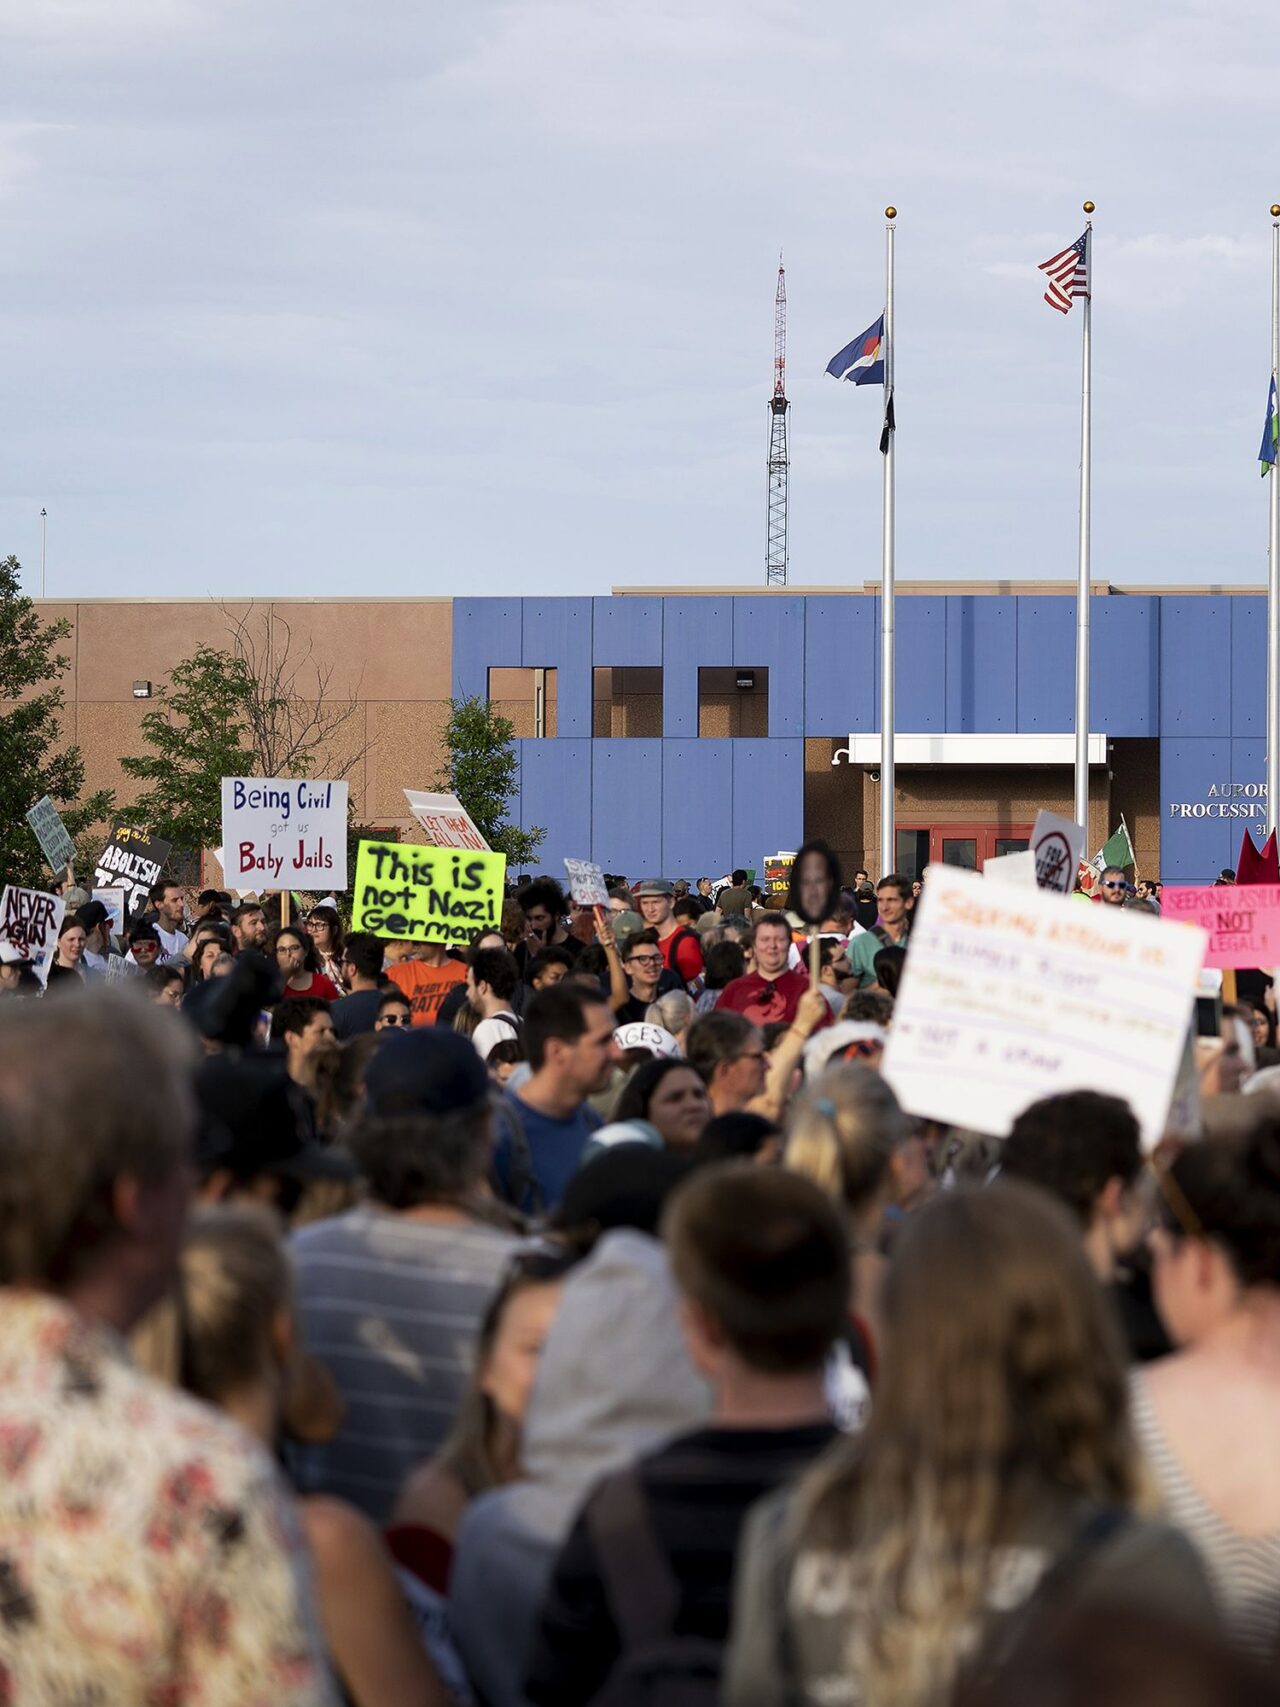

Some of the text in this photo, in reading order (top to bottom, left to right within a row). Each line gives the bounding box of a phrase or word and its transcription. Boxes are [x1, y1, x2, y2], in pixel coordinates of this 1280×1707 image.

[234, 780, 331, 819] Being Civil
[270, 820, 309, 838] got us
[420, 814, 469, 833] LET THEM
[433, 831, 460, 848] ALL
[98, 844, 162, 886] ABOLISH
[239, 836, 333, 878] Baby Jails
[367, 845, 485, 891] This is
[5, 888, 57, 930] NEVER
[362, 885, 494, 921] not Nazi
[1216, 910, 1257, 930] NOT
[0, 917, 47, 948] AGAIN
